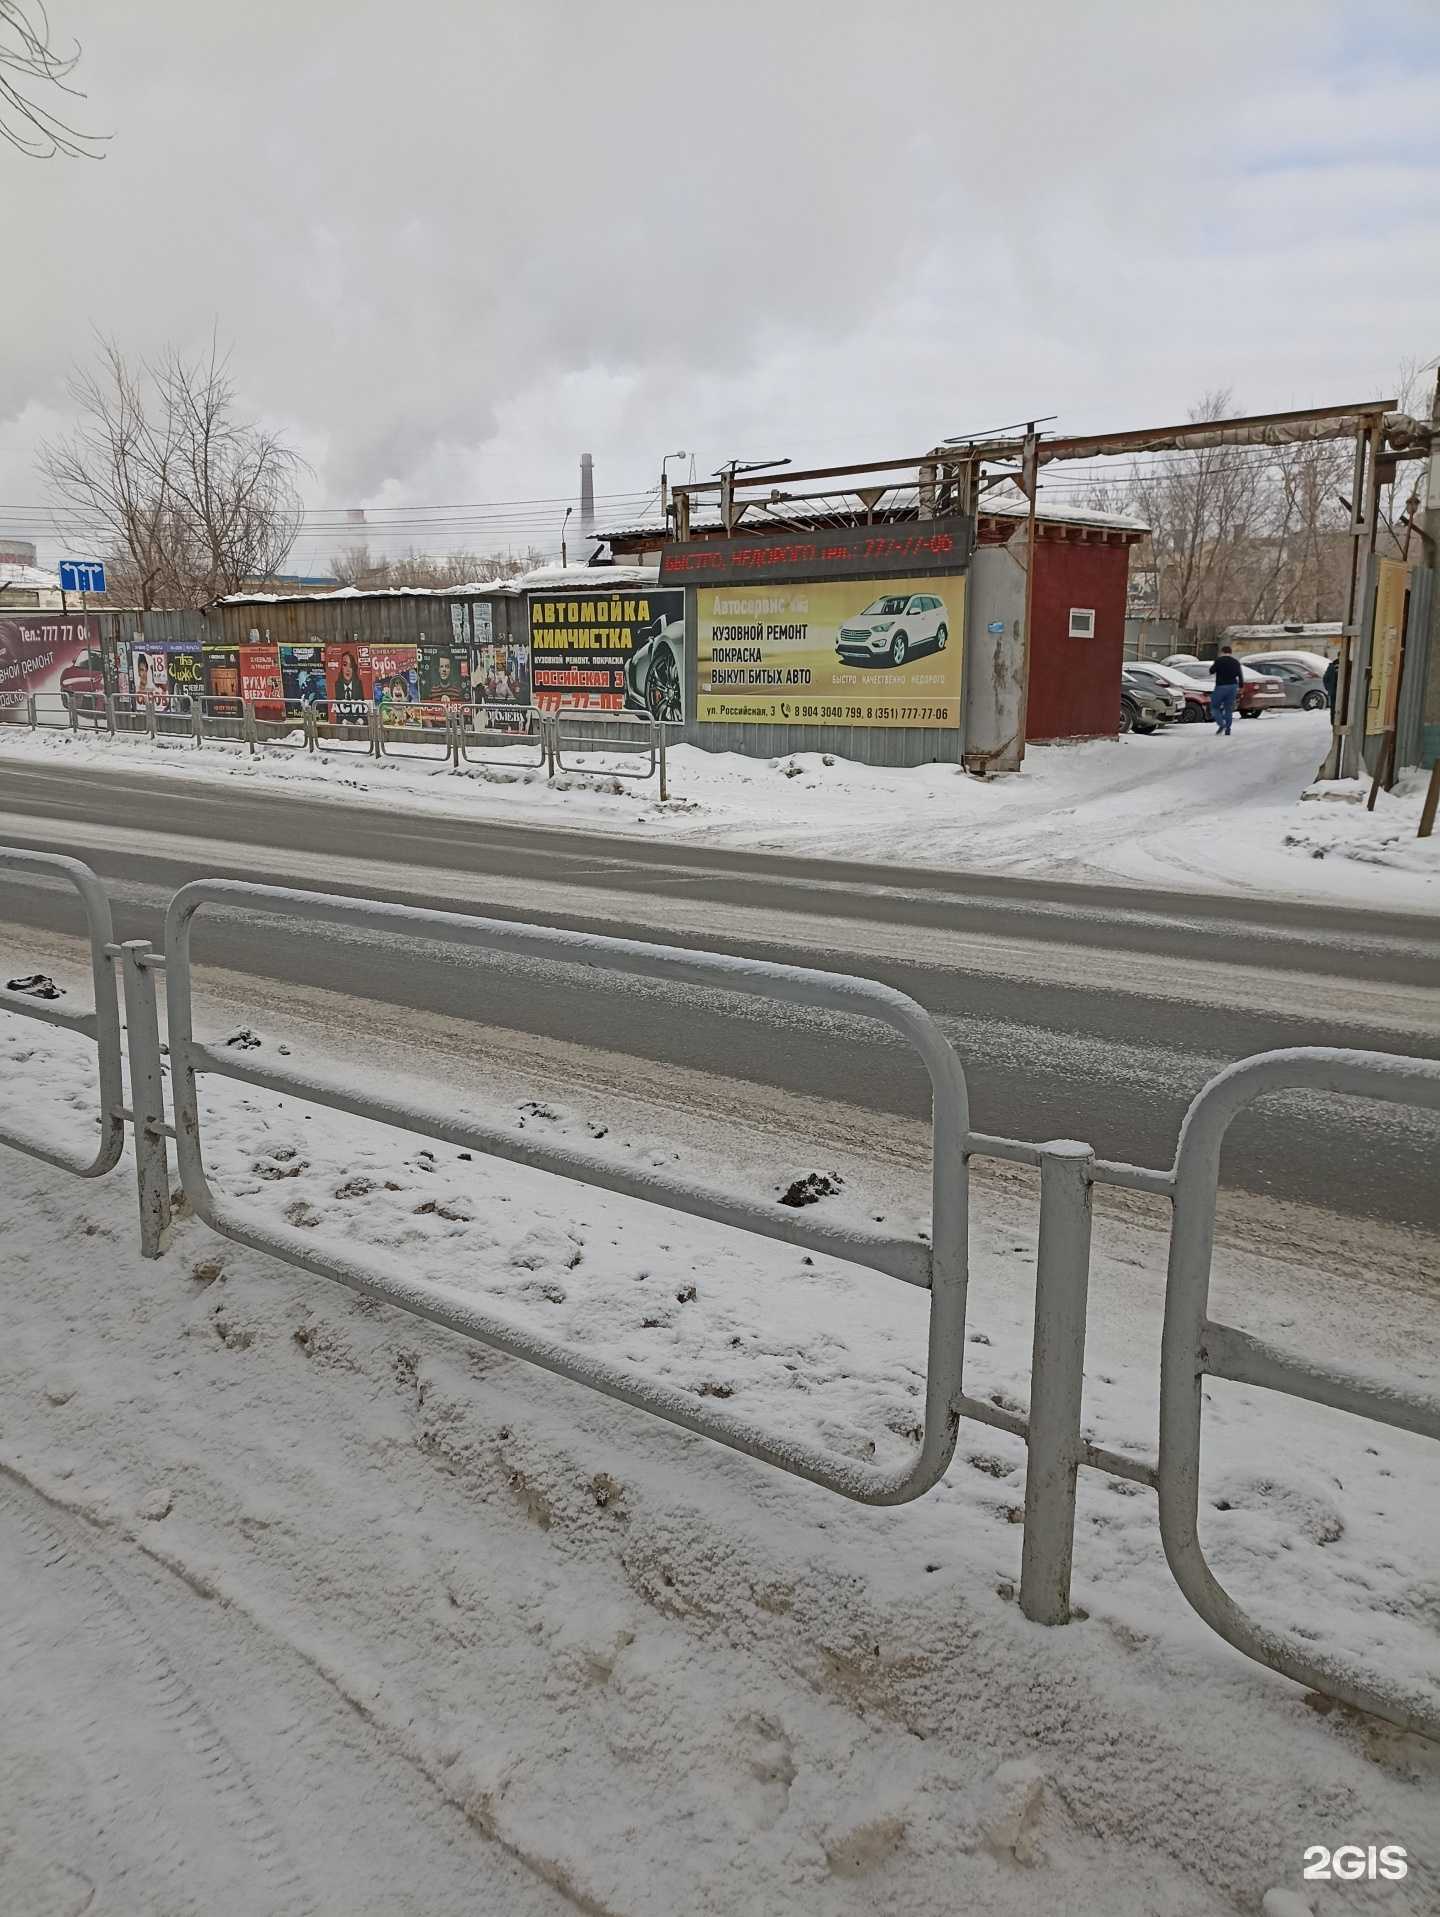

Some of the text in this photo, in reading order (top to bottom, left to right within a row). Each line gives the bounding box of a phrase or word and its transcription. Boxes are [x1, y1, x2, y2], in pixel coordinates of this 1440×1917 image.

[532, 595, 650, 622] АВТОМОЙКА
[713, 595, 784, 617] Автосервис
[19, 626, 41, 642] Тел.:
[42, 625, 58, 640] 777
[61, 625, 73, 640] 77
[533, 628, 633, 648] ХИМЧИСТКА
[712, 622, 808, 641] КУЗОВНОЙ РЕМОНТ
[534, 655, 563, 664] КУЗОВНОЙ
[592, 657, 624, 665] ПОКРАСКА
[712, 648, 762, 662] ПОКРАСКА
[21, 651, 54, 679] ремонт
[534, 666, 624, 688] РОССИЙСКАЯ 3
[712, 669, 811, 684] ВЫКУП БИТЫХ АВТО
[832, 675, 945, 684] БЫСТРО КАЧЕСТВЕННО НЕДОРОГО
[706, 705, 948, 720] ул. Российская, 3 8 904 3040 799, 8 (351) 777-77-06
